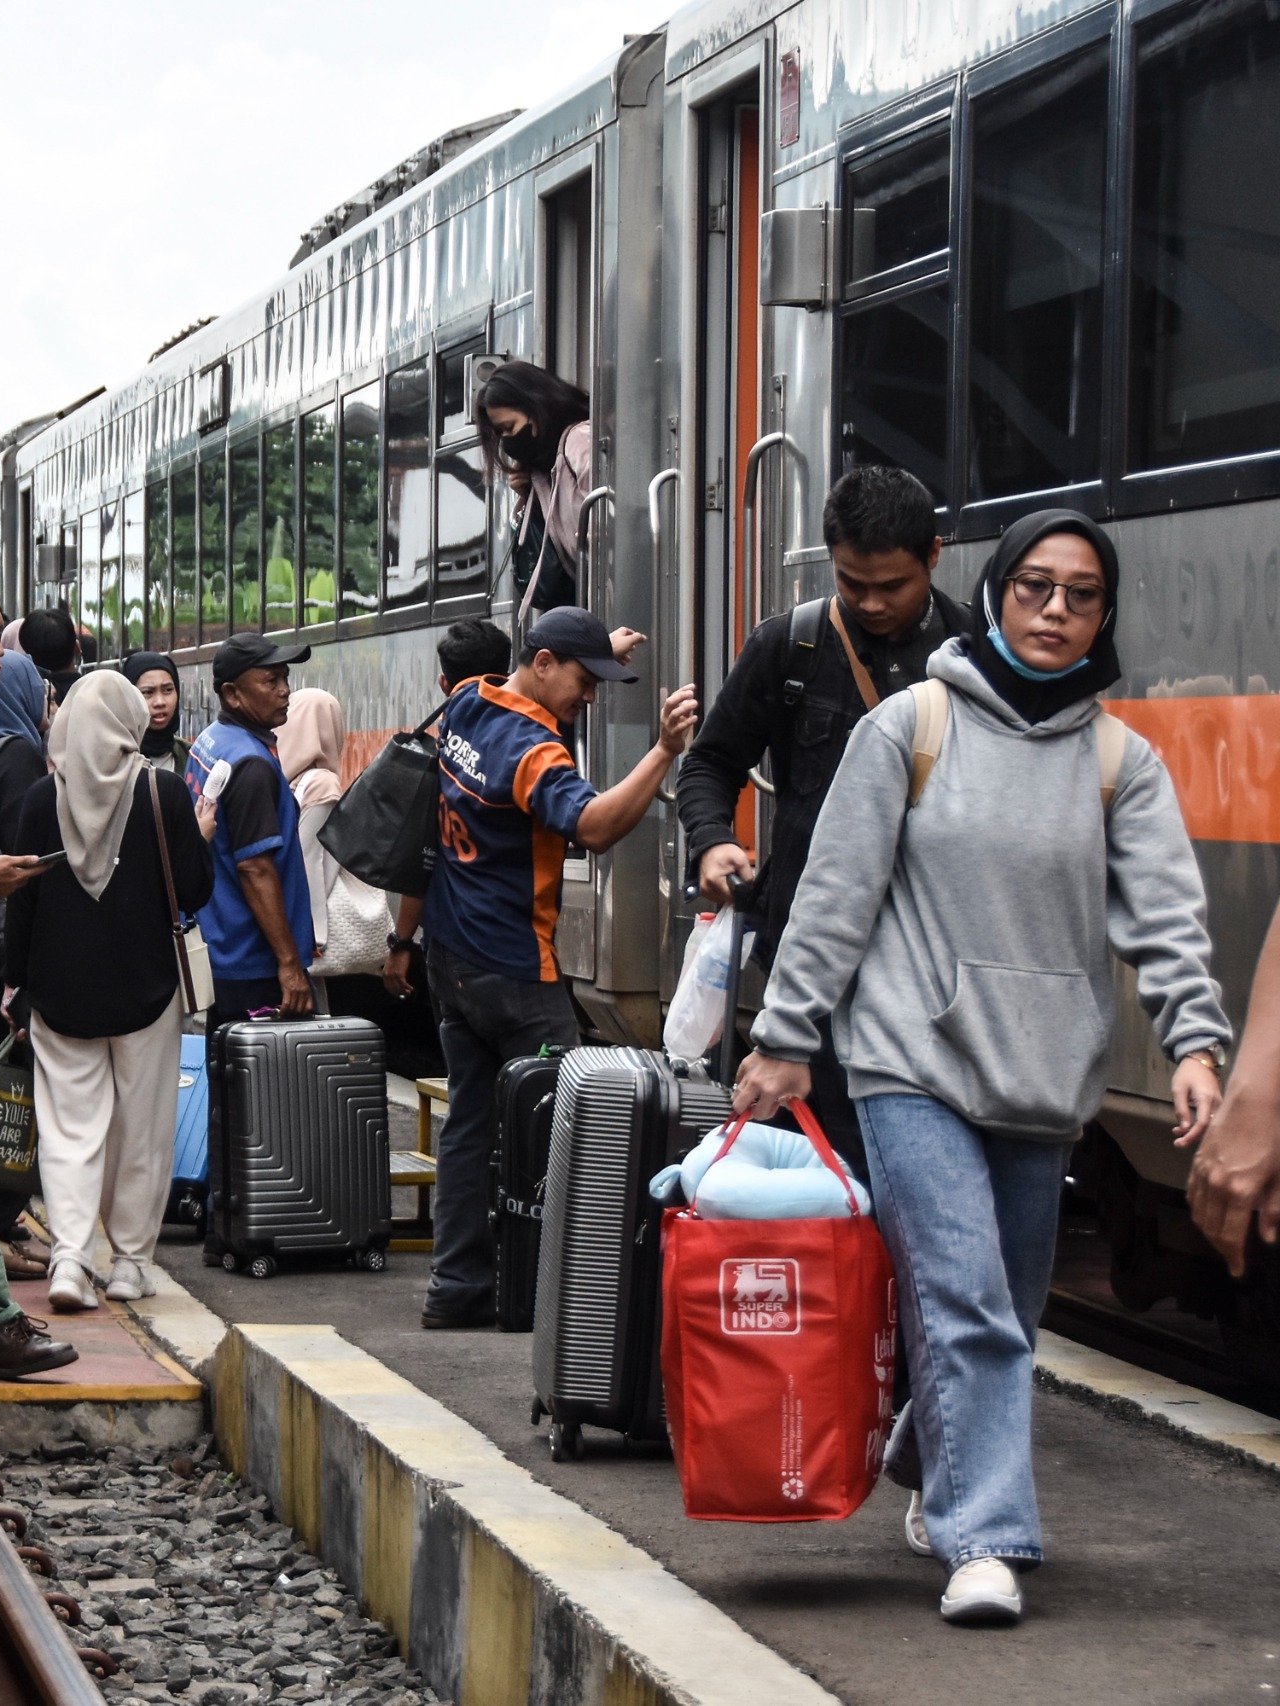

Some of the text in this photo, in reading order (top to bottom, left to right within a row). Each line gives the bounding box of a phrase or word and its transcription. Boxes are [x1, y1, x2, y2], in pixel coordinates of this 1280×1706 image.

[4, 1102, 25, 1125] YOU
[737, 1302, 784, 1312] SUPER
[732, 1311, 790, 1329] INDO
